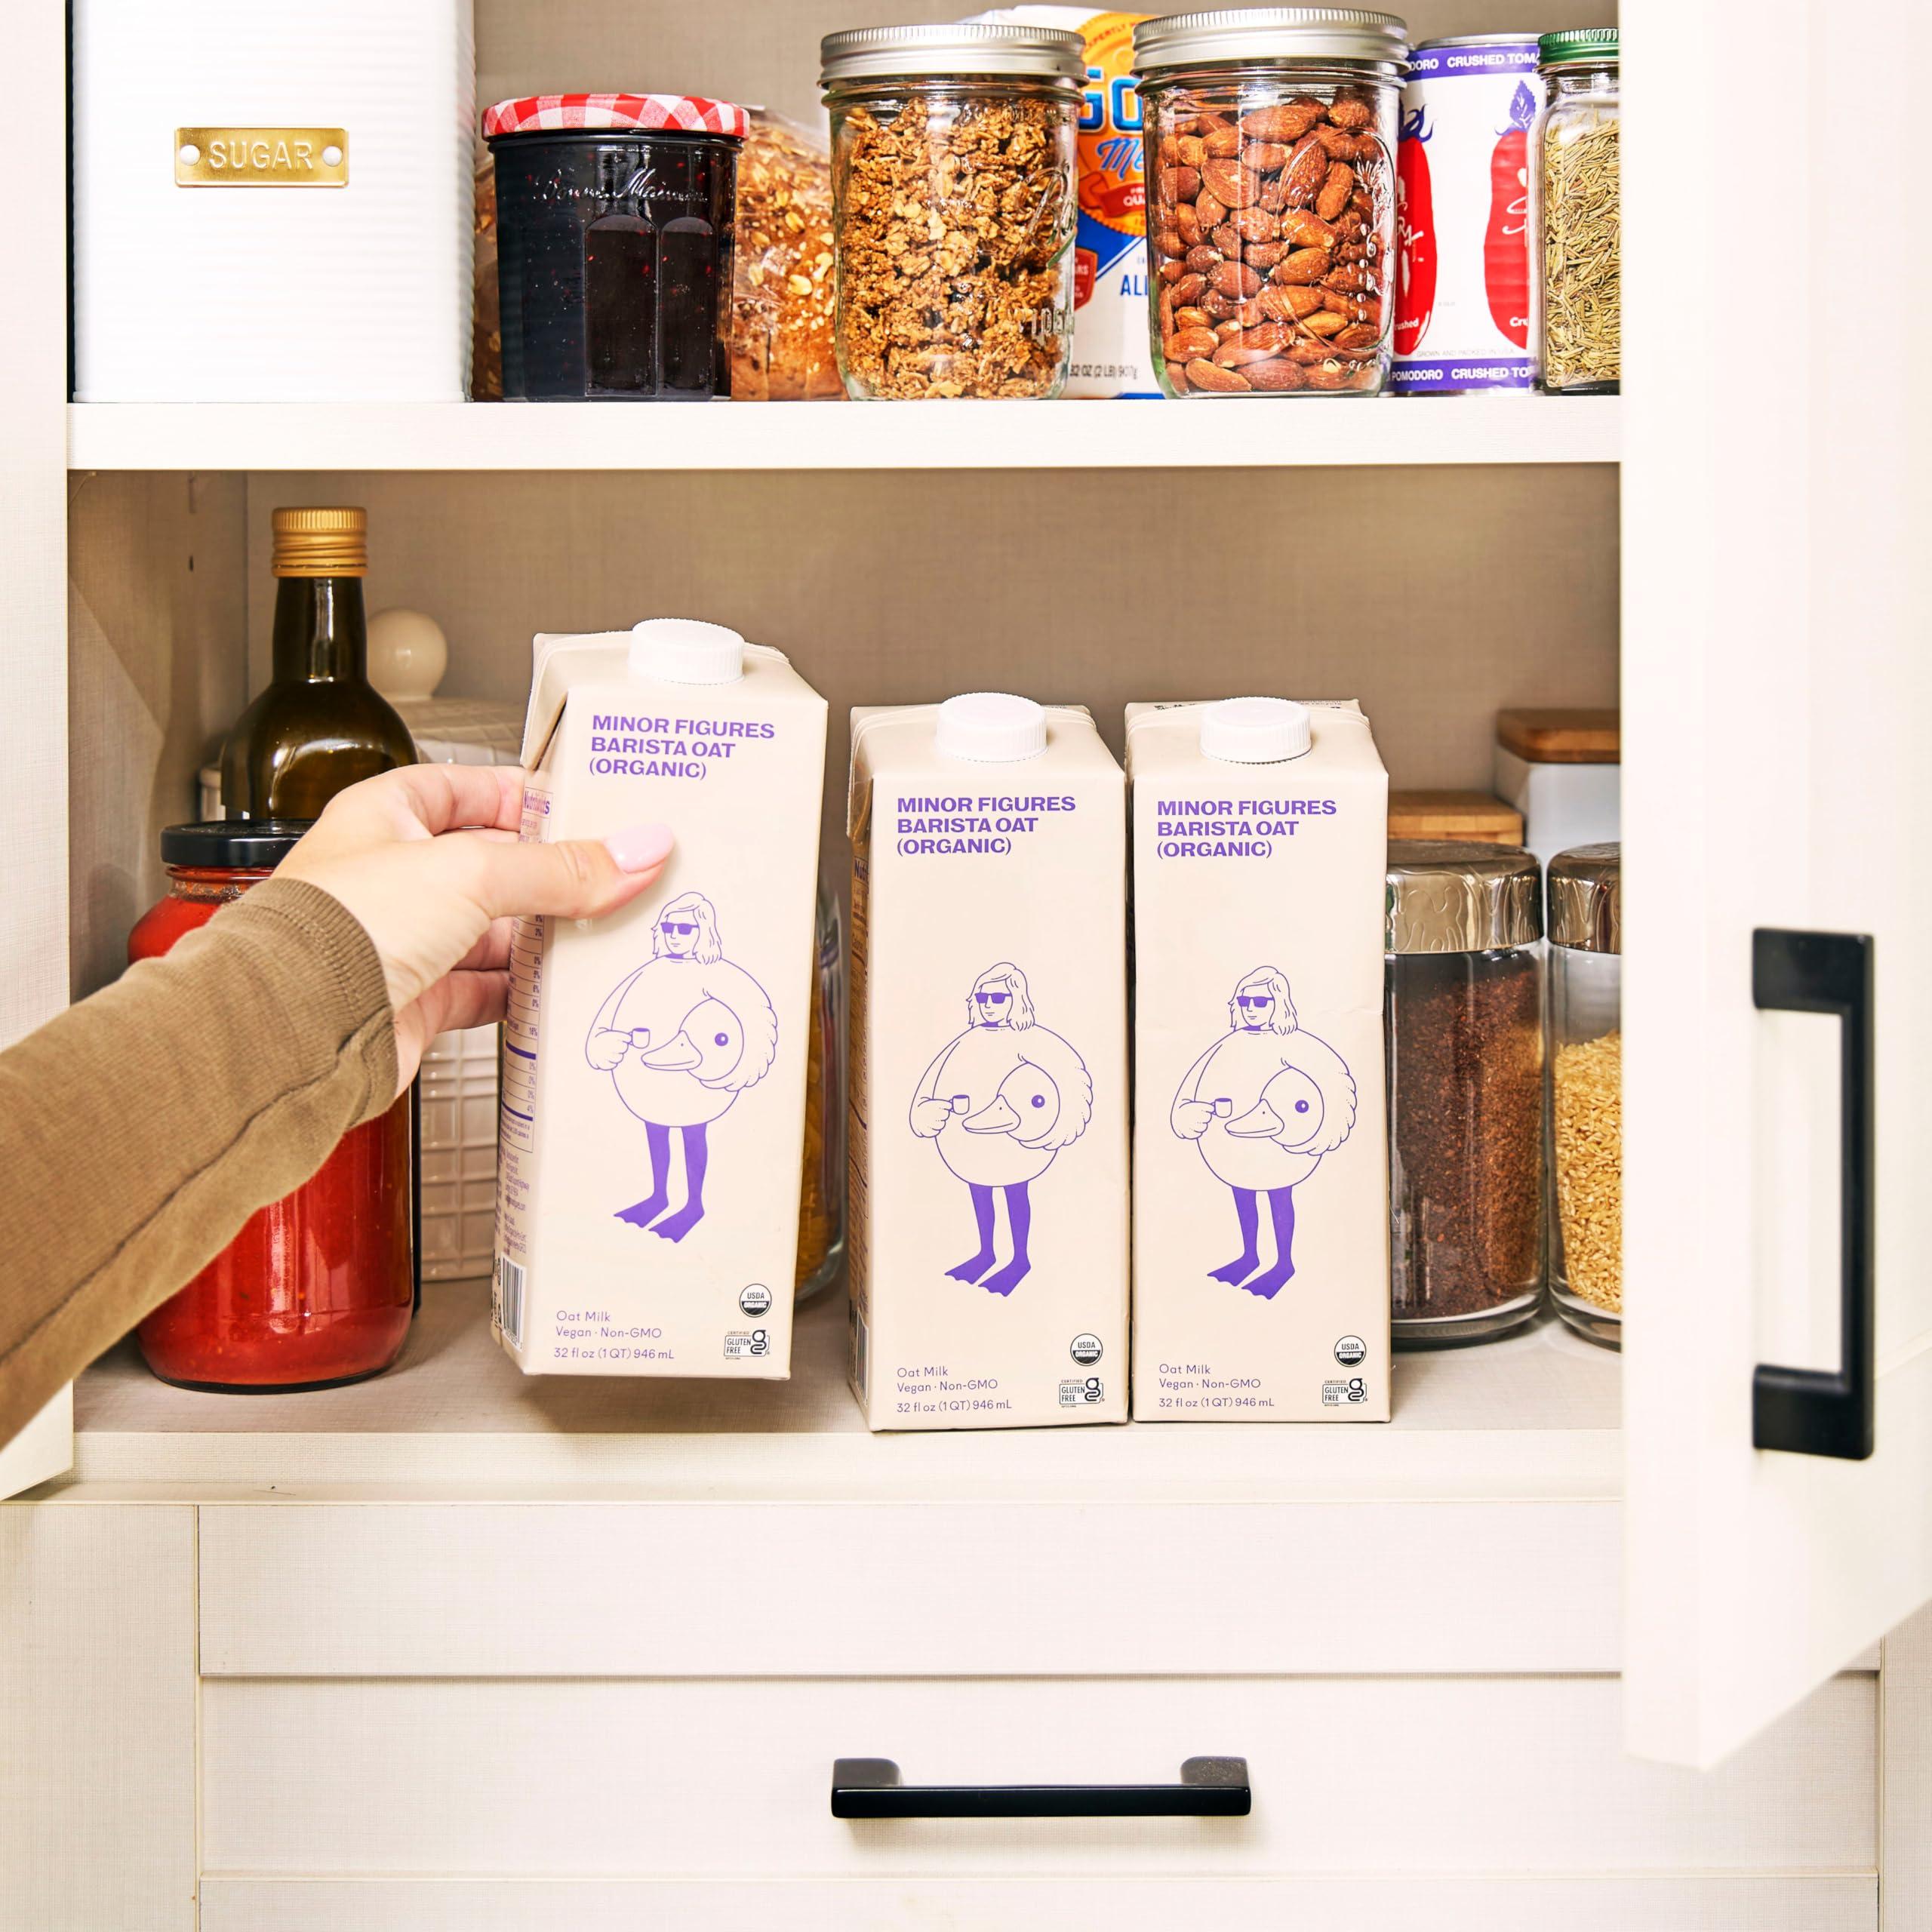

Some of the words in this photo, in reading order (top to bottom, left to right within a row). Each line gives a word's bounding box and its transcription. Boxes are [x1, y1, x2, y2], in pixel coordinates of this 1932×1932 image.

[1447, 54, 1505, 68] CRUSHED
[208, 140, 313, 170] SUGAR
[1123, 195, 1146, 207] QU
[1392, 369, 1444, 381] POMODORO
[1451, 368, 1509, 380] CRUSHED
[592, 715, 669, 734] MINOR
[675, 719, 775, 739] FIGURES
[591, 737, 688, 756] BARISTA
[691, 742, 736, 758] OAT
[589, 757, 706, 780] (ORGANIC)
[897, 798, 973, 813] MINOR
[978, 796, 1076, 811] FIGURES
[1157, 801, 1233, 816] MINOR
[1238, 800, 1337, 815] FIGURES
[897, 818, 992, 834] BARISTA
[995, 817, 1038, 832] OAT
[1157, 821, 1253, 836] BARISTA
[1256, 821, 1300, 835] OAT
[897, 837, 1011, 857] (ORGANIC)
[1157, 840, 1272, 860] (ORGANIC)
[556, 1310, 580, 1321] Oat
[585, 1311, 611, 1322] Milk
[555, 1326, 592, 1340] Vegan
[601, 1327, 662, 1338] Non-GMO
[554, 1347, 568, 1358] 32
[571, 1347, 579, 1358] fl
[581, 1350, 595, 1358] oz
[633, 1349, 656, 1359] 946
[658, 1349, 674, 1359] mL
[897, 1367, 920, 1377] Oat
[924, 1366, 949, 1377] Milk
[1159, 1364, 1182, 1374] Oat
[1186, 1364, 1211, 1374] Milk
[897, 1382, 931, 1394] Vegan
[940, 1379, 998, 1391] Non-GMO
[1159, 1378, 1193, 1390] Vegan
[1202, 1378, 1261, 1389] Non-GMO
[897, 1403, 910, 1412] 32
[914, 1401, 921, 1412] fl
[973, 1400, 994, 1410] 946
[996, 1399, 1012, 1409] mL
[1159, 1398, 1172, 1407] 32
[1176, 1398, 1183, 1407] fl
[1235, 1398, 1257, 1407] 946
[1259, 1398, 1275, 1407] mL
